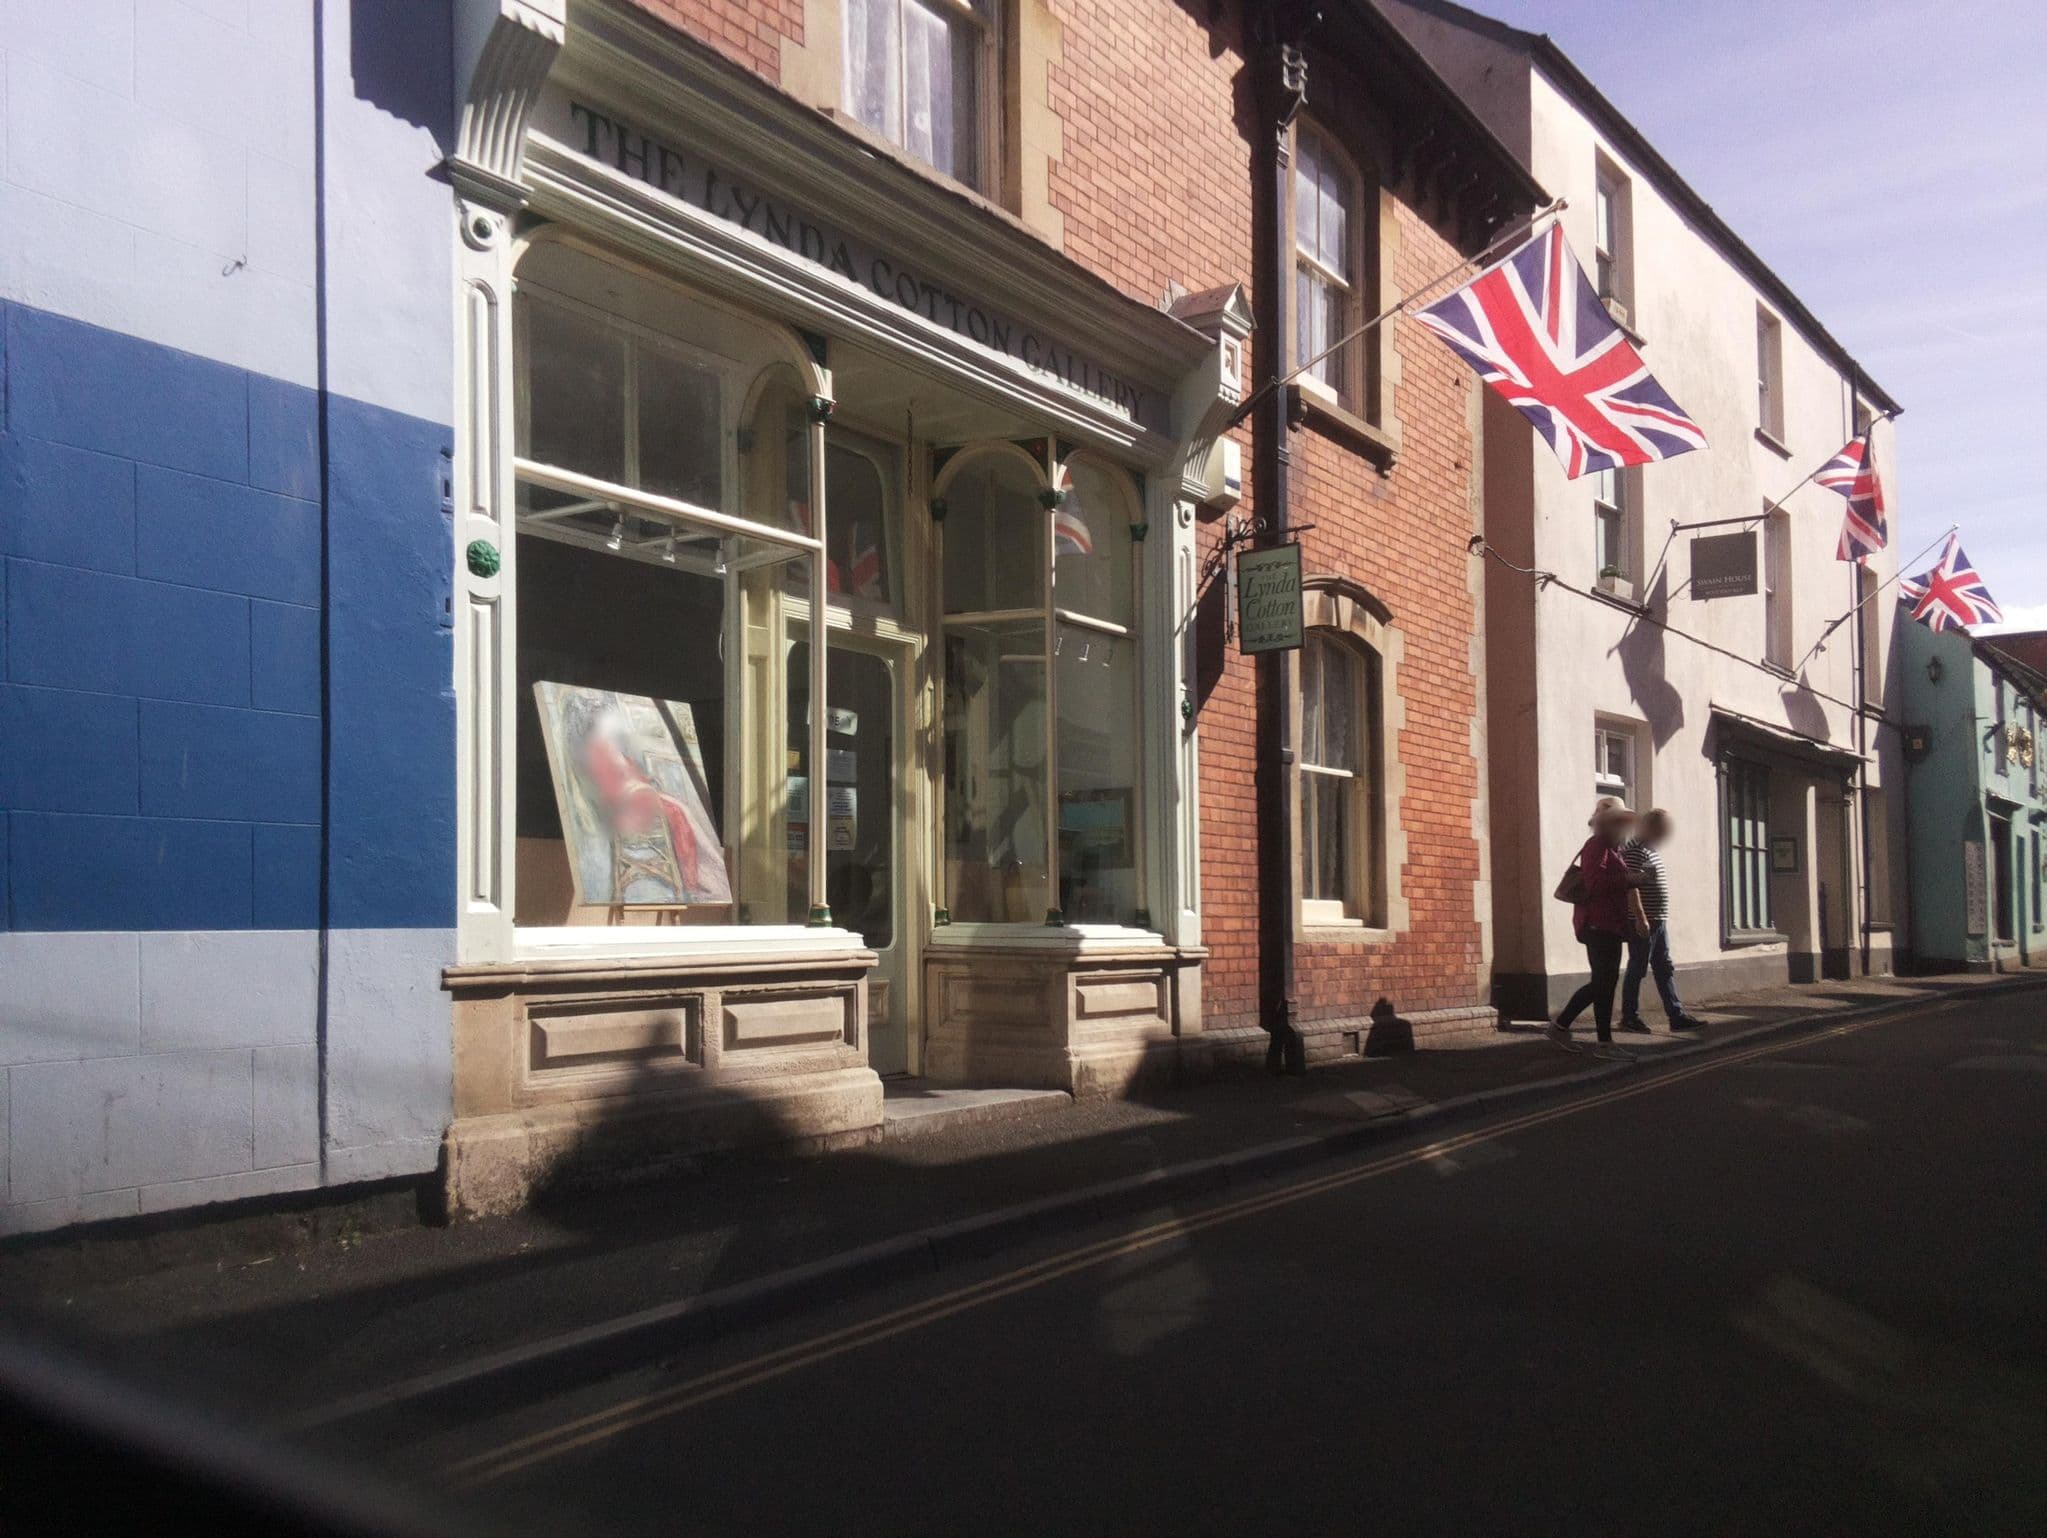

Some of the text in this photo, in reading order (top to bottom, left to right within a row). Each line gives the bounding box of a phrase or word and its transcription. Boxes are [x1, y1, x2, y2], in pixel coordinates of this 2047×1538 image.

[571, 102, 1144, 421] THE LYNDA COTTON GALLERY
[1242, 572, 1296, 600] Lynda
[1724, 574, 1752, 583] HOUSE
[1246, 598, 1295, 620] Cotton
